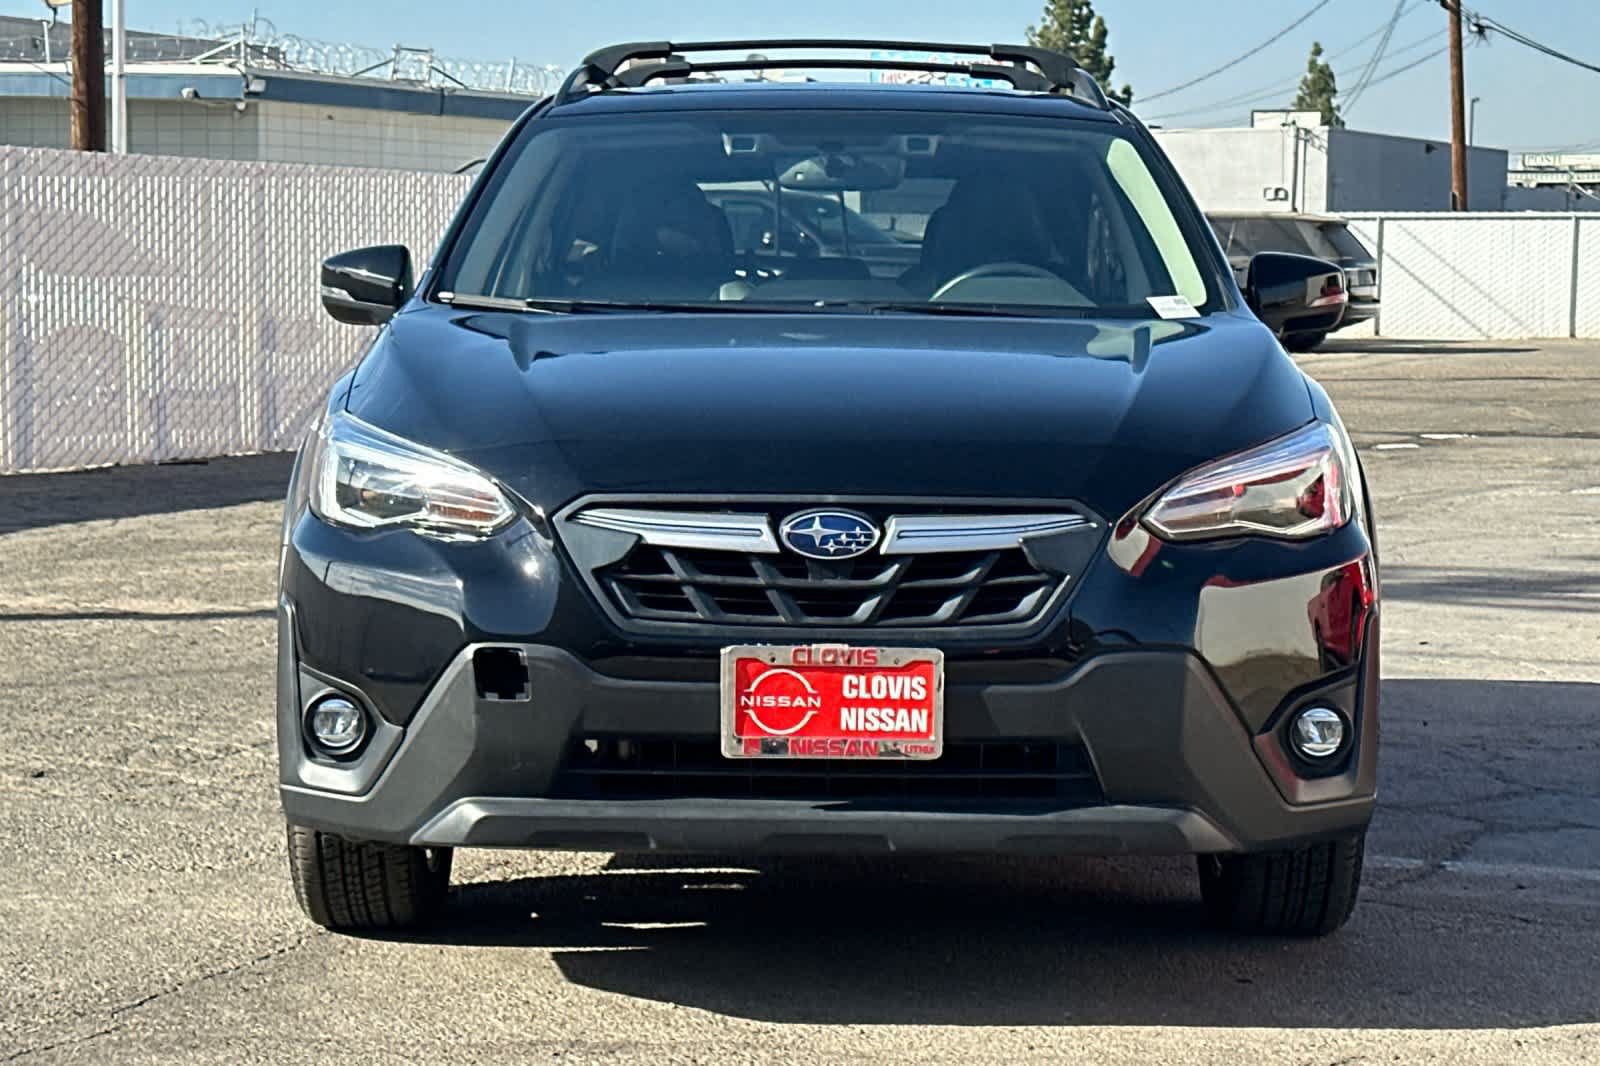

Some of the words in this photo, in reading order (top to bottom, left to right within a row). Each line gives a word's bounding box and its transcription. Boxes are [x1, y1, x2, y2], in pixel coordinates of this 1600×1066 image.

[792, 647, 878, 666] CLOVIS
[842, 674, 928, 700] CLOVIS
[741, 695, 821, 708] NISSAN
[840, 707, 929, 733] NISSAN
[788, 738, 880, 757] NISSAN
